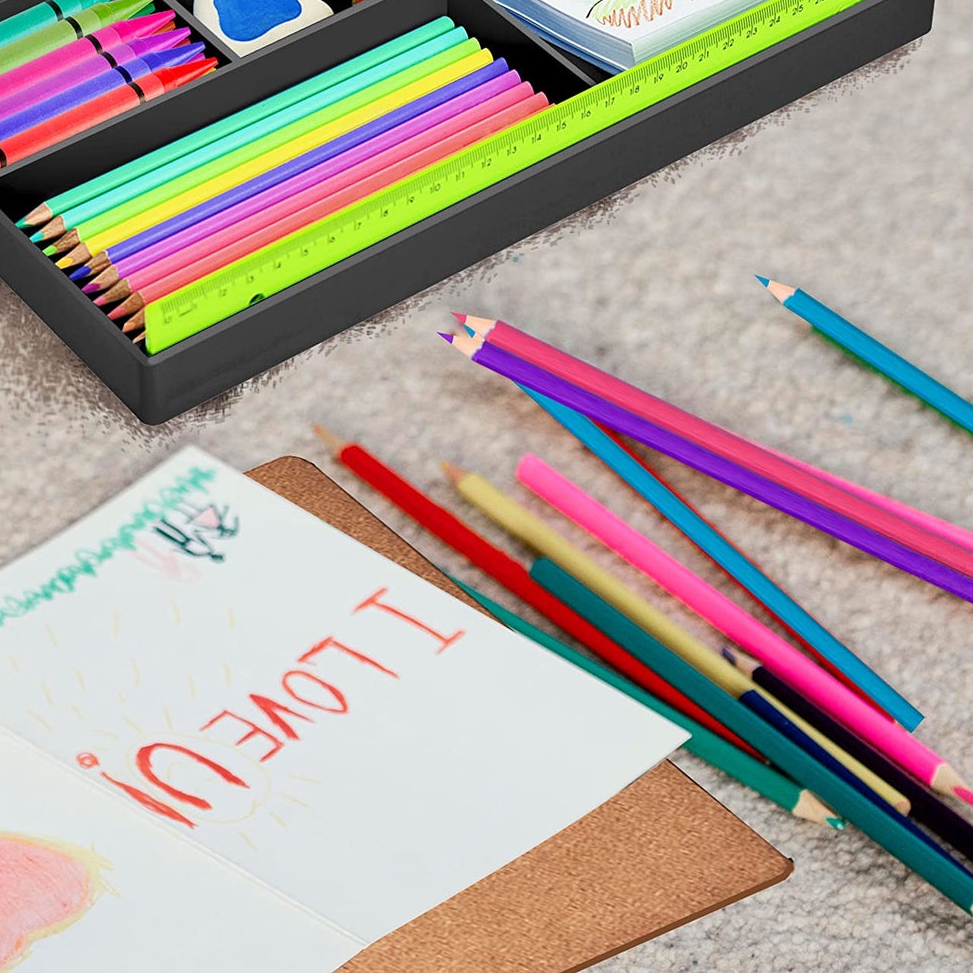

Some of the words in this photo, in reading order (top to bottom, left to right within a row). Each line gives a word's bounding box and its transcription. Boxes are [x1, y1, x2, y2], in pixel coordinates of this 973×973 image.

[429, 183, 441, 193] 10
[455, 171, 465, 181] 11
[481, 158, 492, 168] 12
[506, 146, 517, 156] 13
[531, 134, 542, 144] 14
[556, 122, 567, 131] 15
[581, 110, 591, 119] 16
[605, 97, 615, 107] 17
[629, 85, 640, 95] 18
[653, 73, 664, 83] 19
[675, 61, 688, 73] 20
[698, 51, 709, 62] 21
[723, 38, 734, 50] 22
[746, 27, 758, 39] 23
[769, 16, 781, 27] 24
[792, 4, 804, 16] 25
[350, 587, 466, 655] I
[198, 635, 400, 763] LOVE
[76, 741, 251, 830] U!
